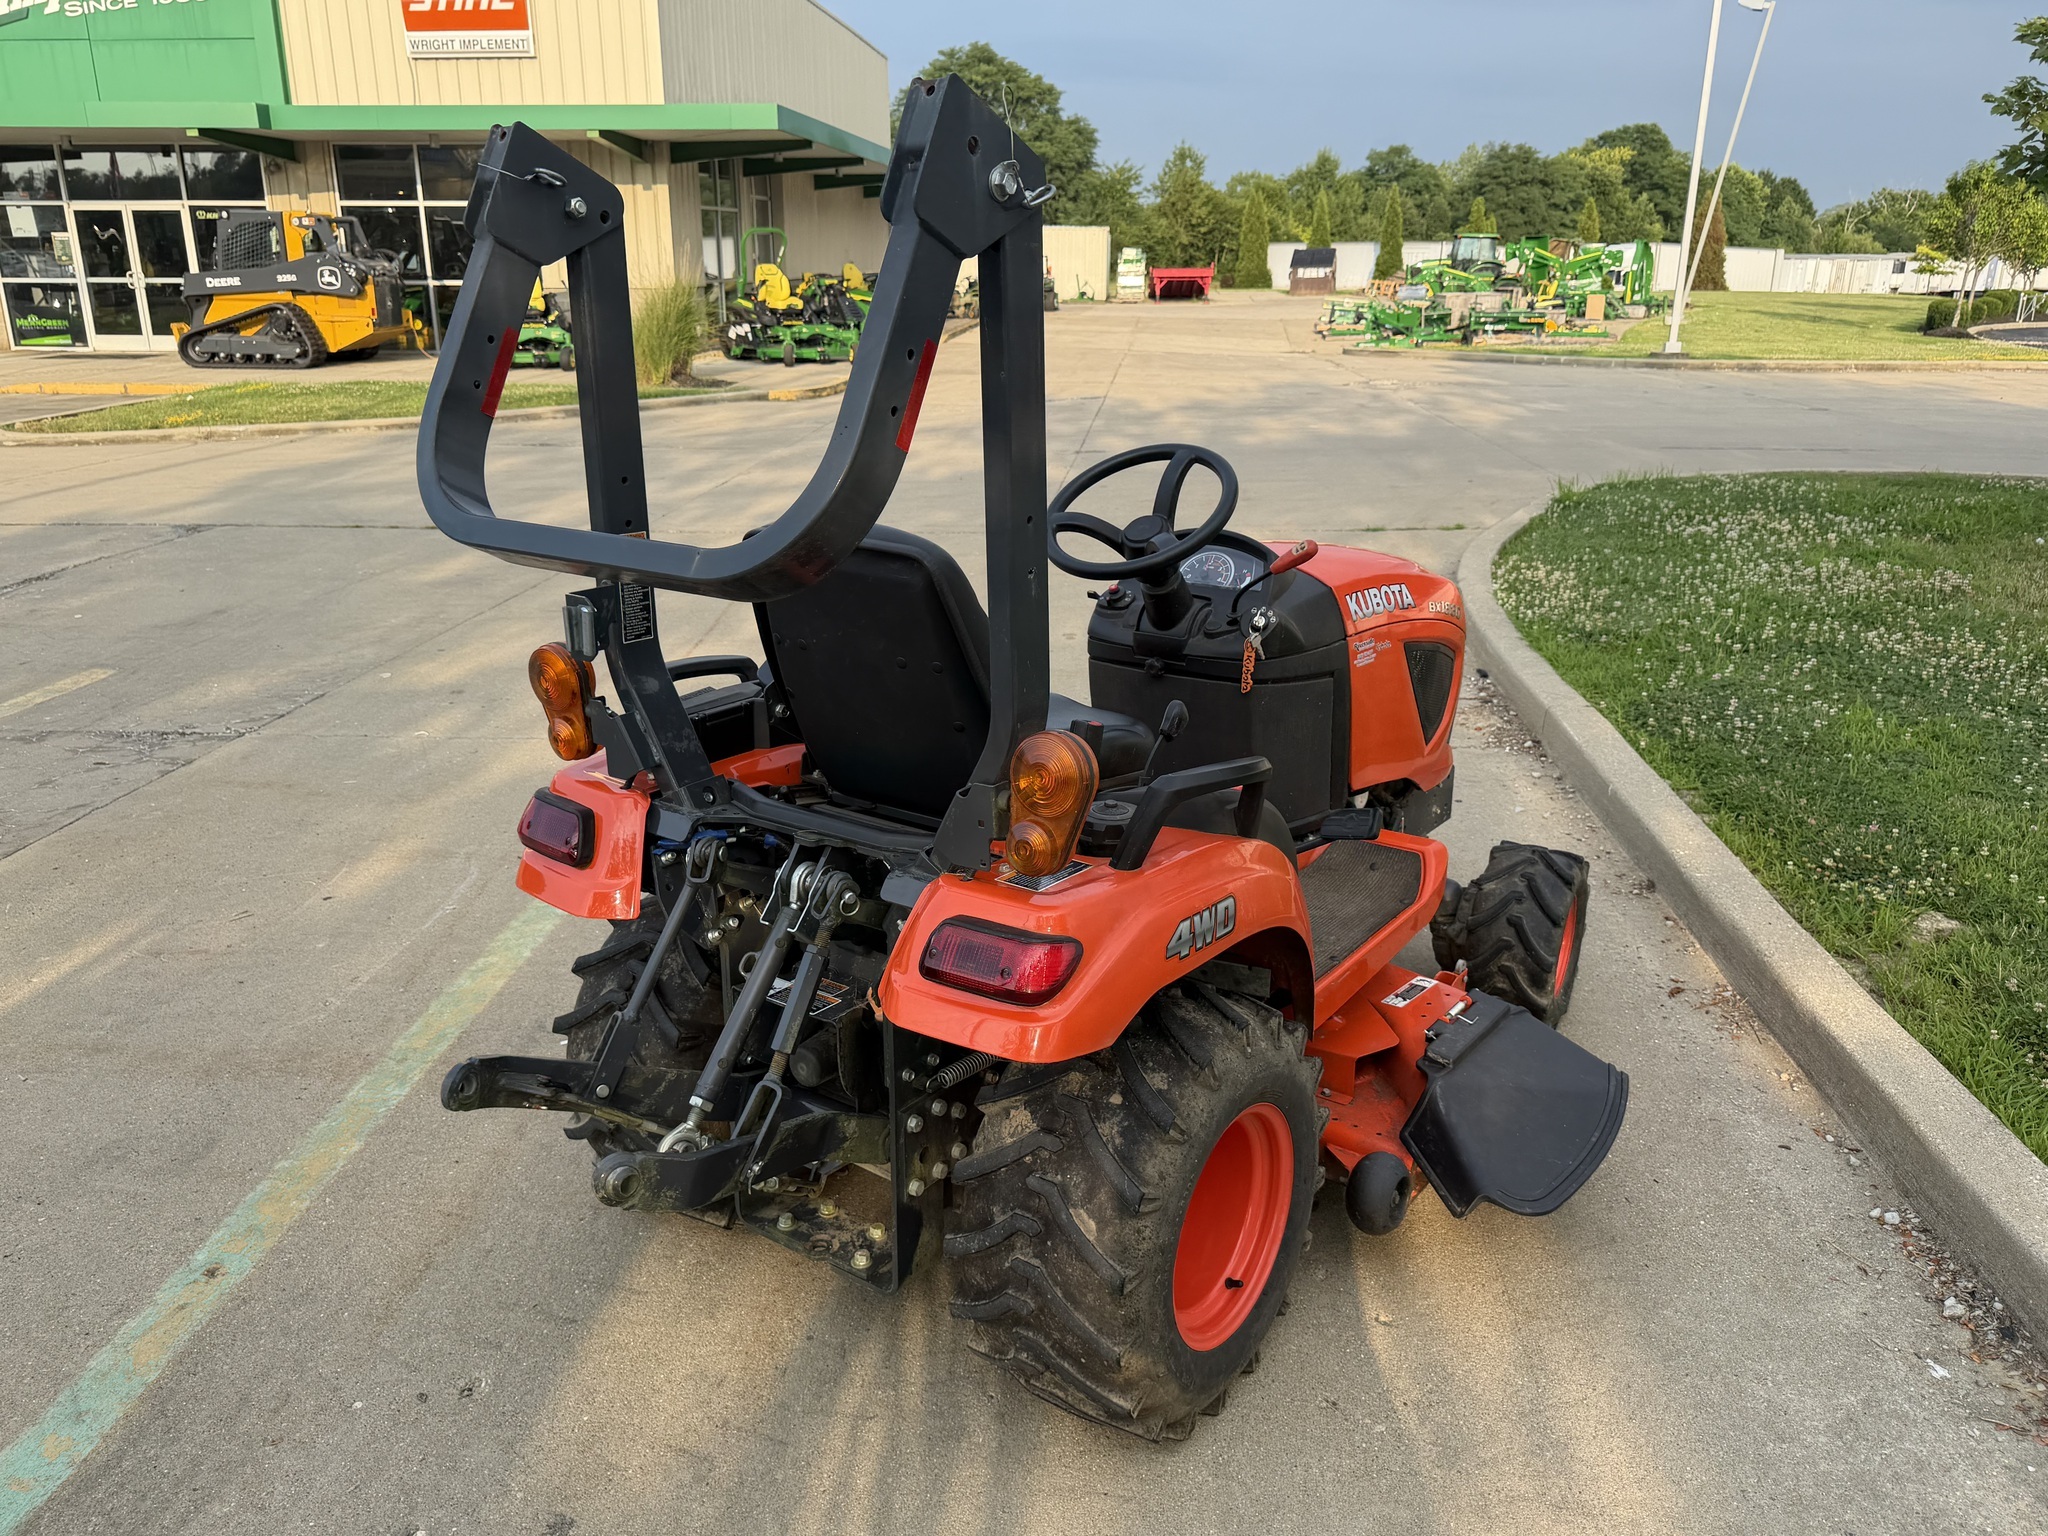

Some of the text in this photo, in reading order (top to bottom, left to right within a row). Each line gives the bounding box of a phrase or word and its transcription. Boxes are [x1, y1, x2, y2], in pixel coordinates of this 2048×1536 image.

[65, 0, 138, 17] SINCE
[409, 38, 527, 51] WRIGHT IMPLEMENT
[205, 276, 242, 288] DEERE
[1345, 583, 1416, 622] KUBOTA
[1242, 654, 1253, 692] Kubota
[1166, 893, 1237, 960] 4WD
